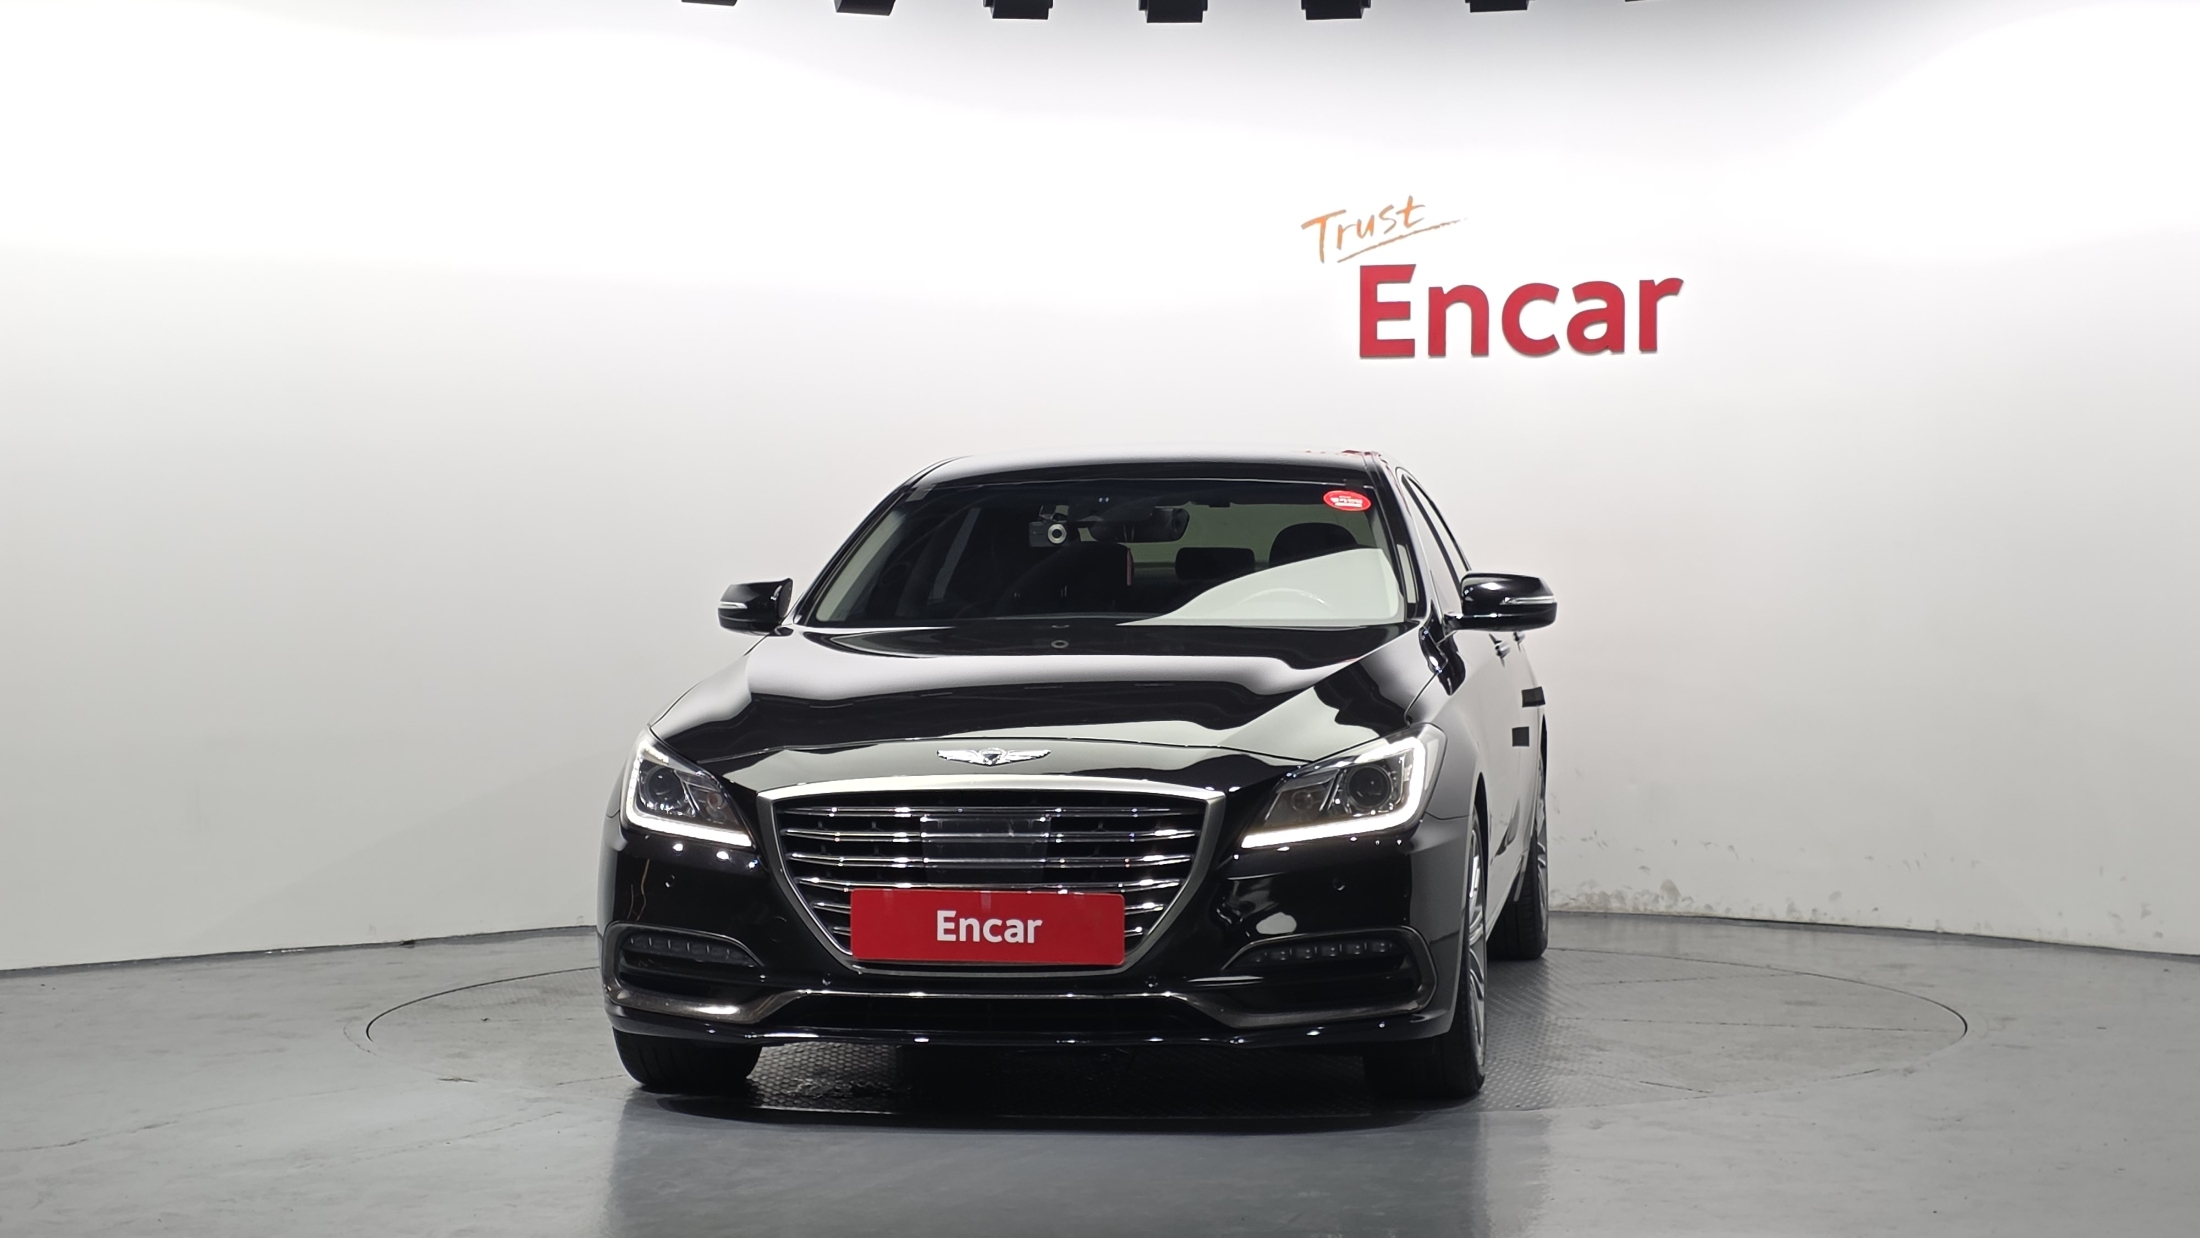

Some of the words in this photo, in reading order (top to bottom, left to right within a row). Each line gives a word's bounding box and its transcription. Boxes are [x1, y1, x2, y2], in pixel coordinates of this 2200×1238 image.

[1300, 195, 1427, 263] Trust
[1359, 264, 1684, 358] Encar
[936, 910, 1043, 944] Encar
